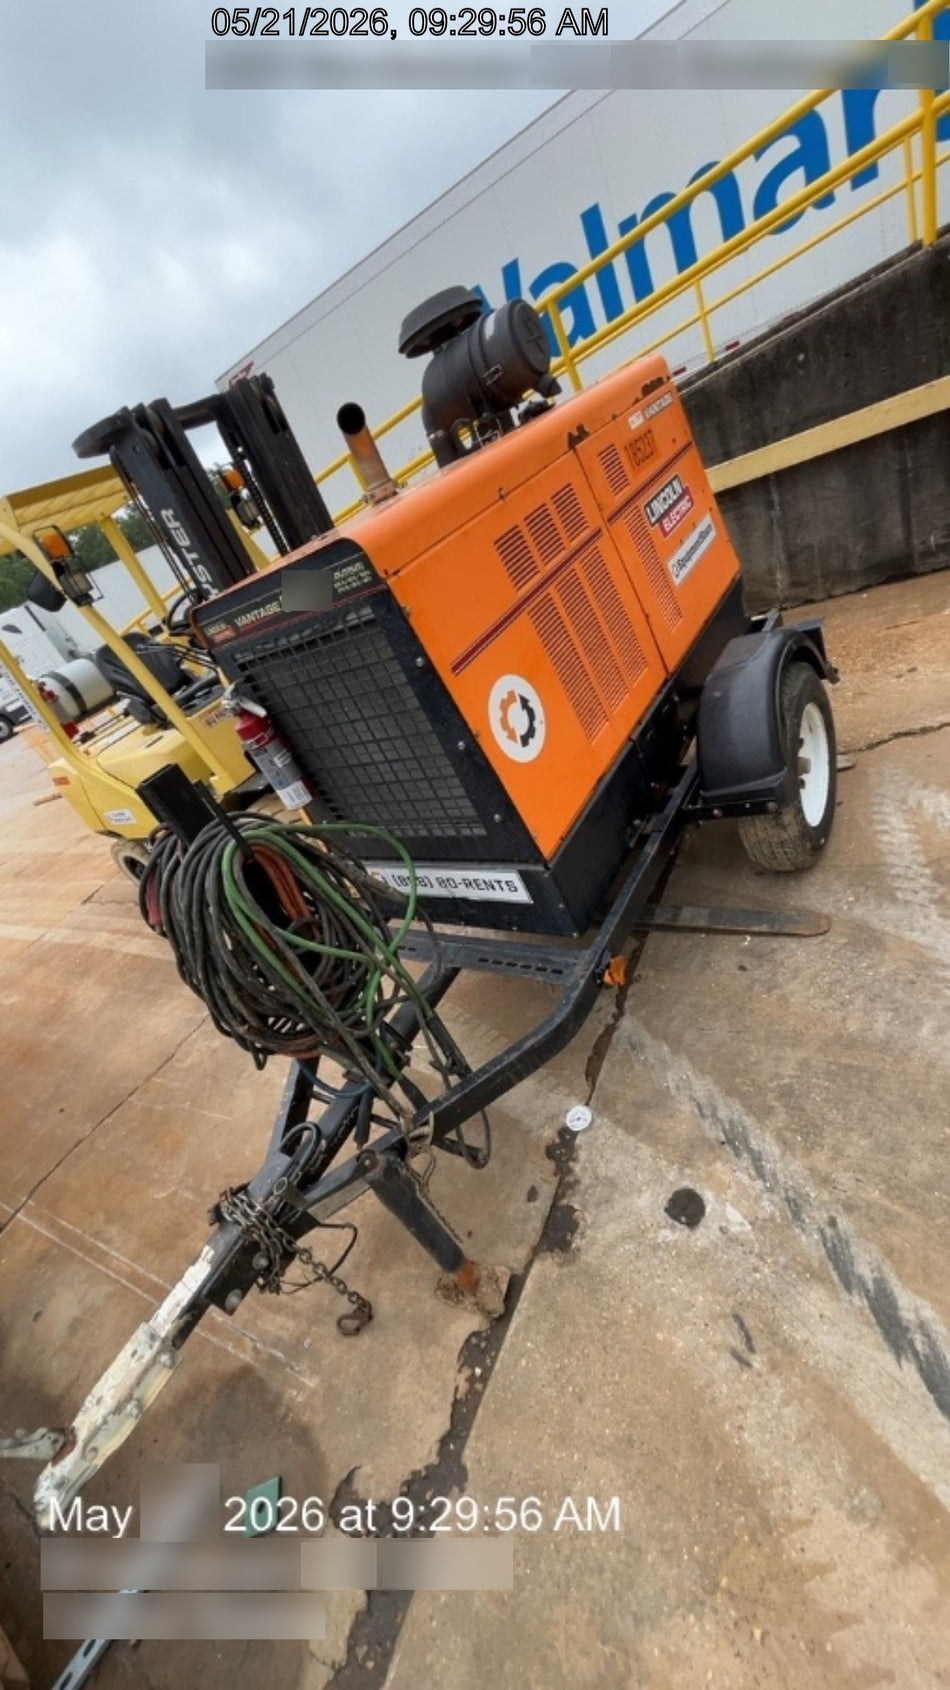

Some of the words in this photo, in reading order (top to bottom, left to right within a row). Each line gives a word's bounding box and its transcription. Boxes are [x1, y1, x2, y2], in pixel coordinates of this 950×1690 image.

[474, 0, 950, 358] almar
[646, 475, 685, 525] LINCOLN
[662, 494, 693, 533] ELECTRIC
[161, 508, 219, 603] YSTER
[233, 600, 281, 628] VANTAGE
[435, 876, 519, 893] 80-RENTS
